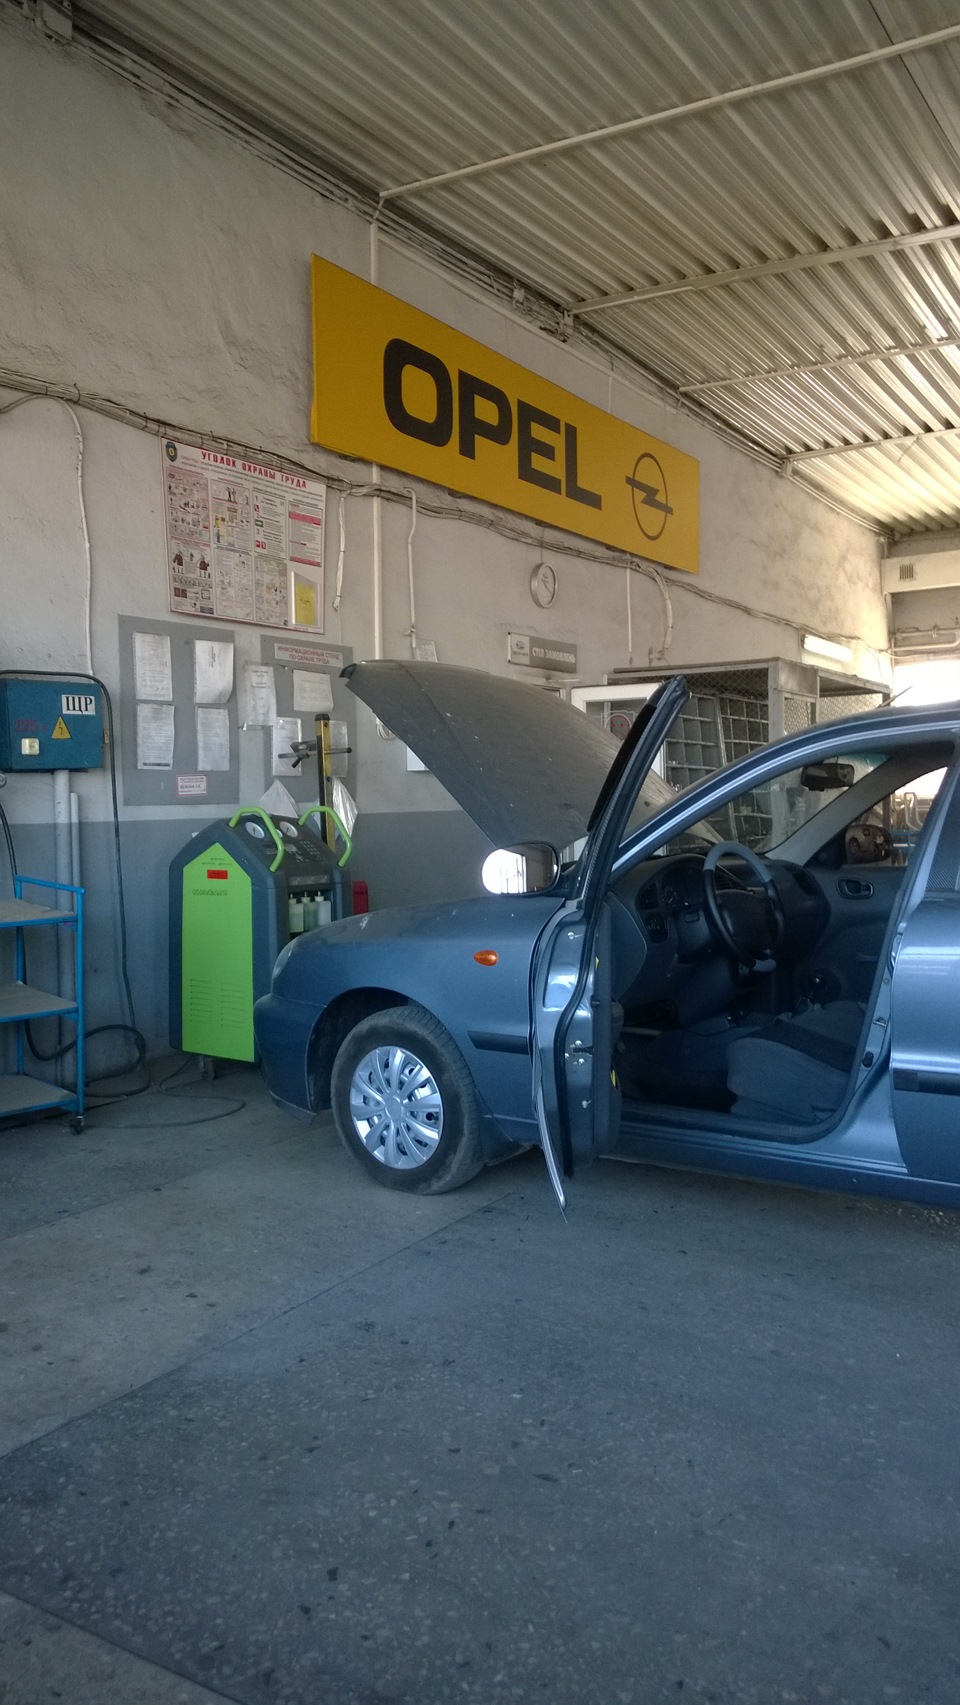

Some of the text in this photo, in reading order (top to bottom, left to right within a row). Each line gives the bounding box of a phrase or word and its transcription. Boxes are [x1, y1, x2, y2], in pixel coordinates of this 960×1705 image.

[383, 338, 602, 511] OPEL
[201, 451, 237, 468] УГОЛОК
[281, 475, 307, 488] ТРУДА
[278, 646, 324, 656] ИНФОРМАЦИОННЫЙ
[545, 649, 576, 663] ЗАМОВЛЕНЬ
[65, 696, 93, 714] ЩР
